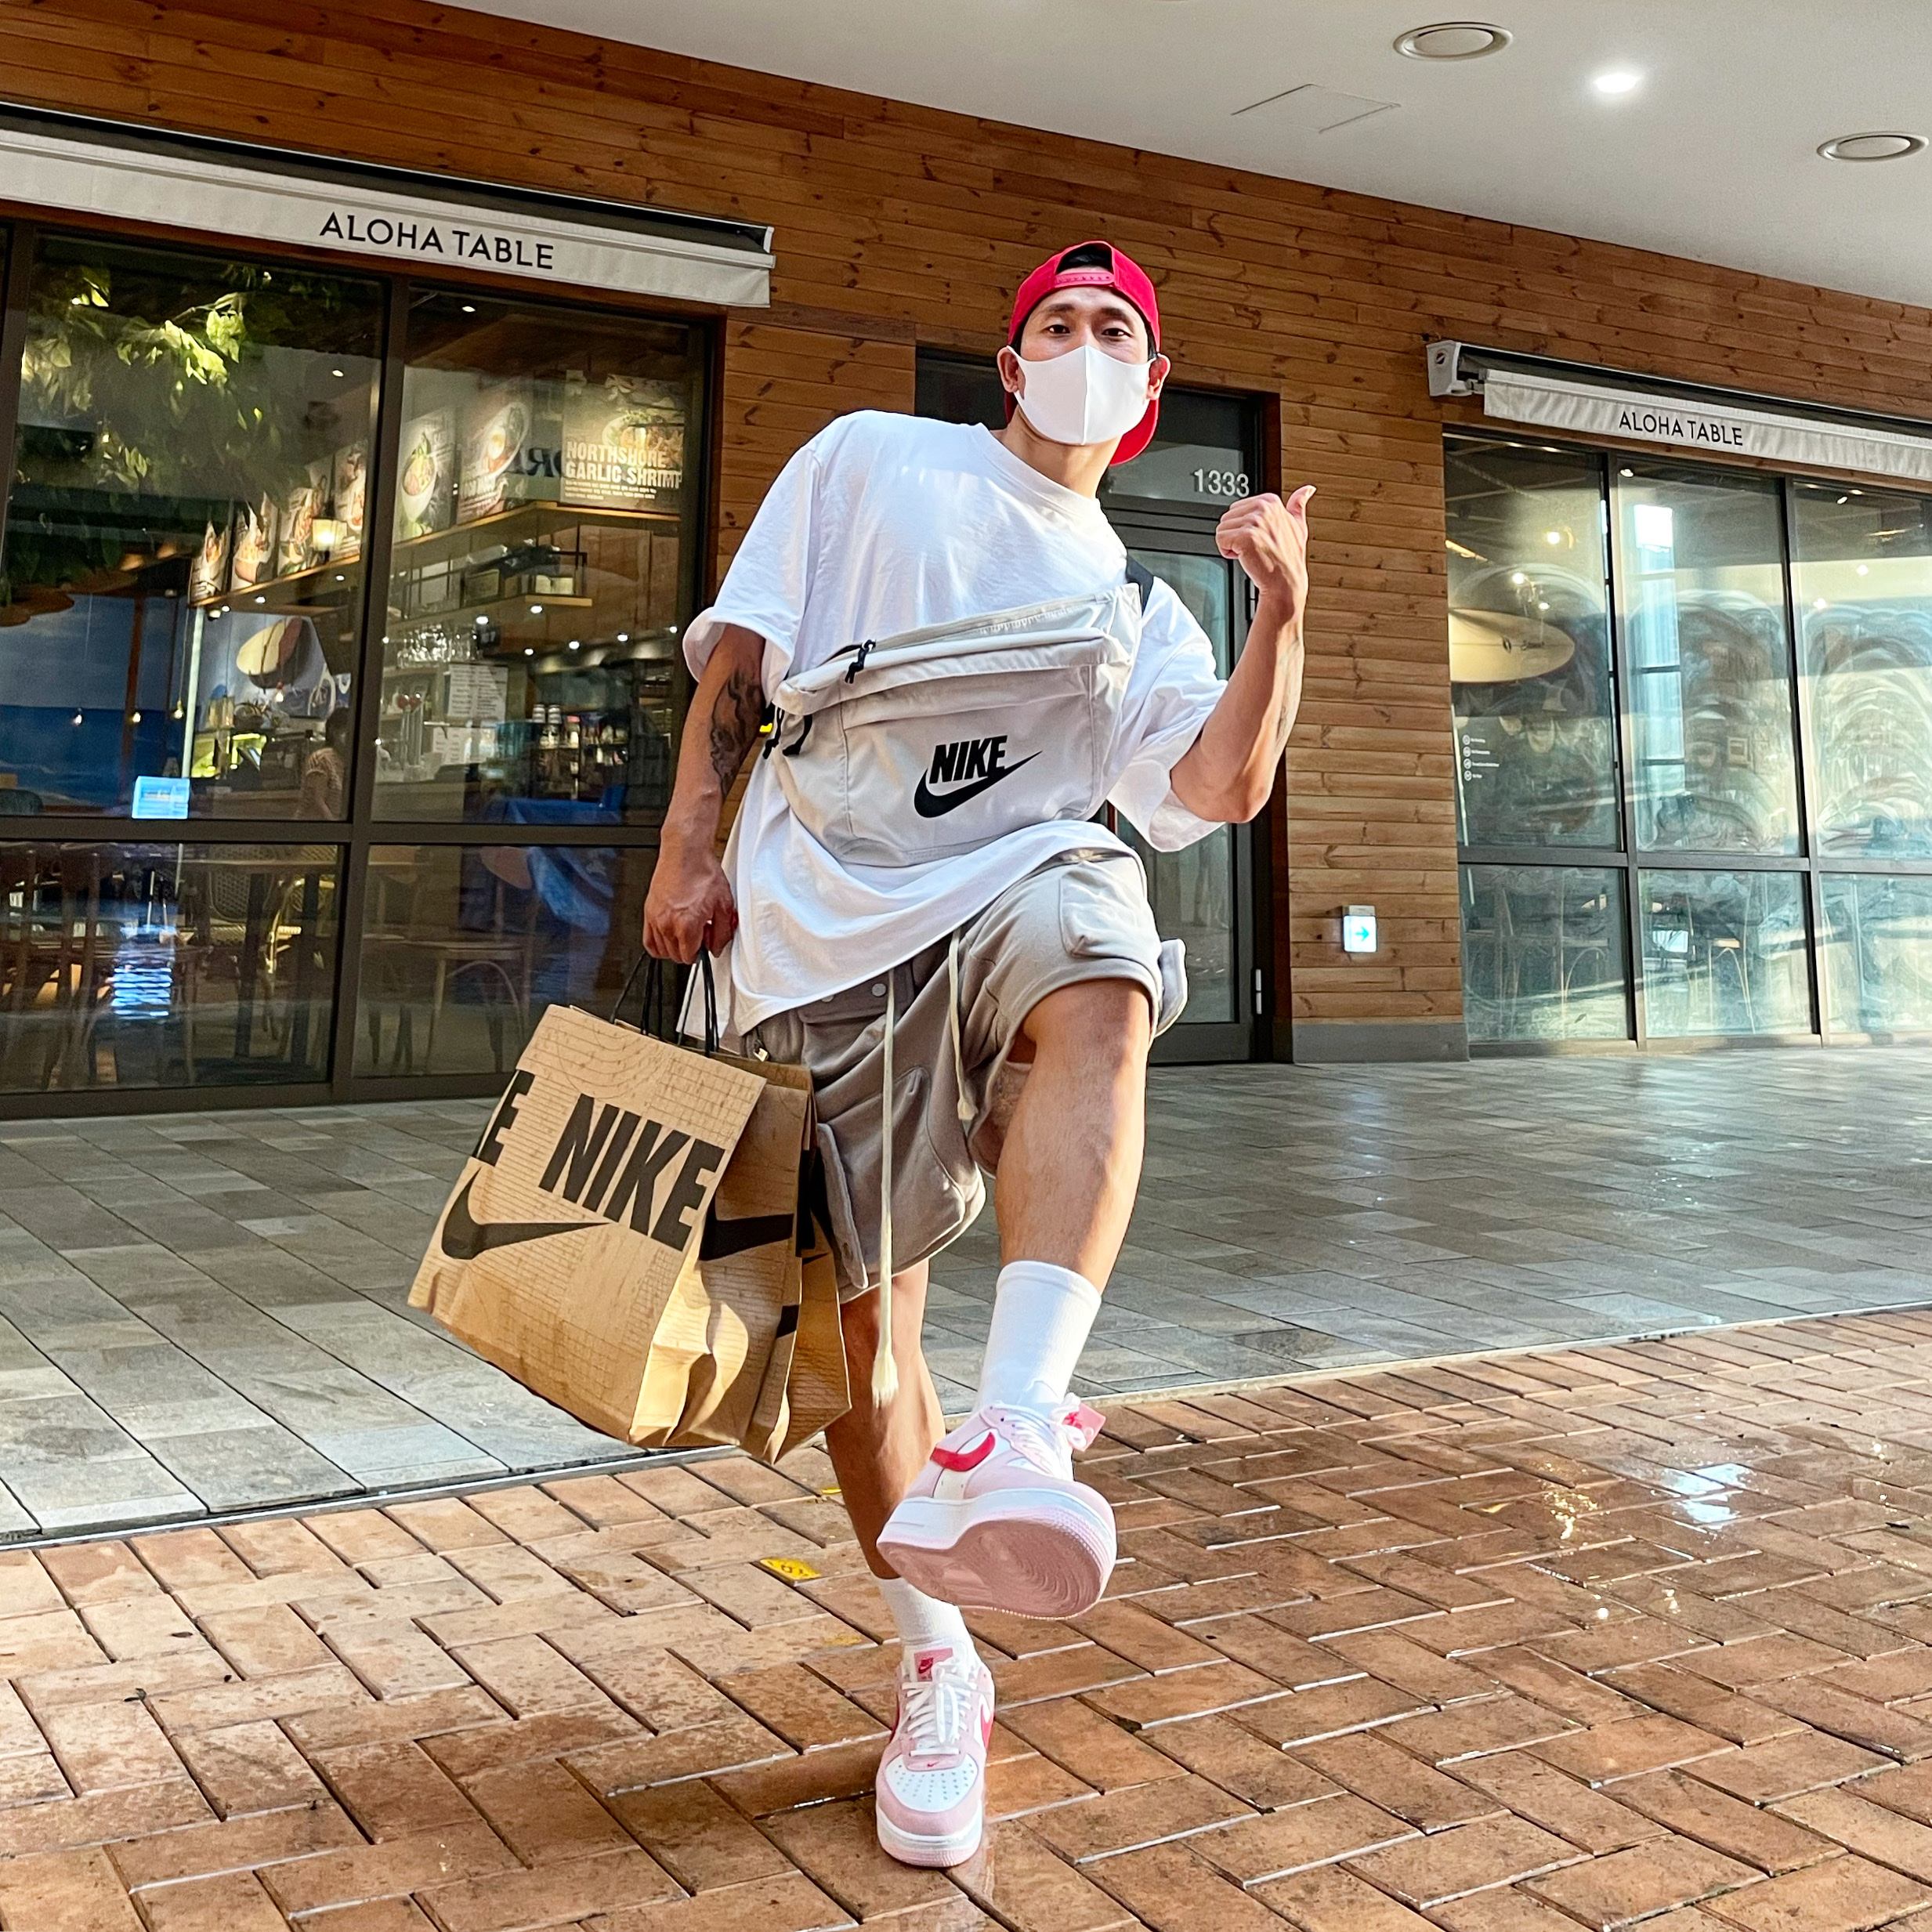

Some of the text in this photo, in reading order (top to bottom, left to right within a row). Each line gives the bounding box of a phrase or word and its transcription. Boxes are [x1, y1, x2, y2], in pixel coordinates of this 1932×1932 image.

[319, 212, 553, 270] ALOHA TABLE
[1619, 411, 1743, 446] ALOHA TABLE
[565, 461, 622, 483] GARLIC
[1194, 468, 1250, 497] 1333
[929, 735, 1008, 784] NIKE
[538, 1093, 725, 1252] NIKE
